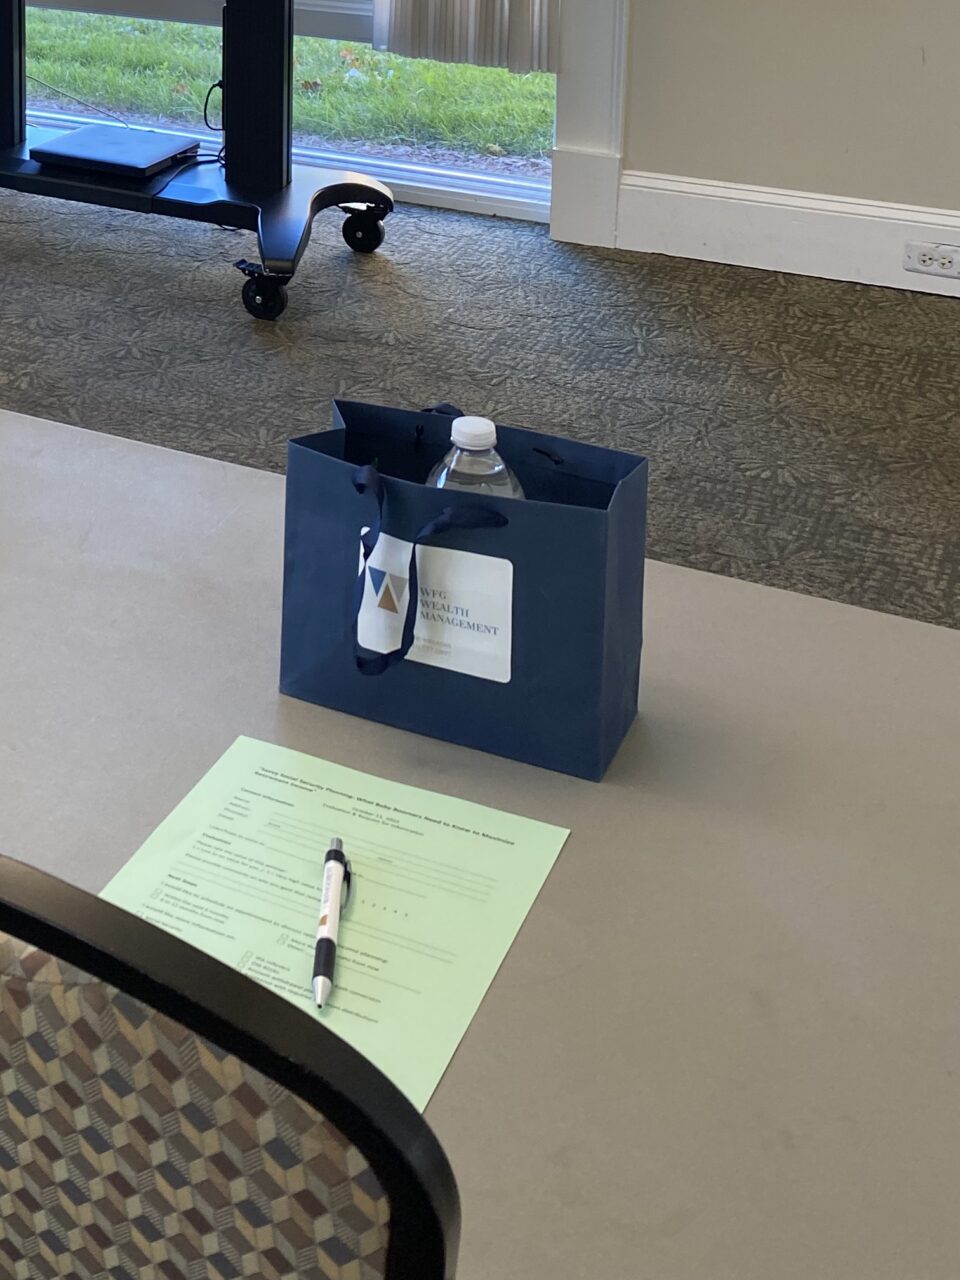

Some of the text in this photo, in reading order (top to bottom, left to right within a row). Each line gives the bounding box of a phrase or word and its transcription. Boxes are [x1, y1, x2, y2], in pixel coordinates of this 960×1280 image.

[420, 587, 447, 600] WFG
[420, 600, 470, 618] WEALTH
[420, 611, 500, 636] MANAGEMENT
